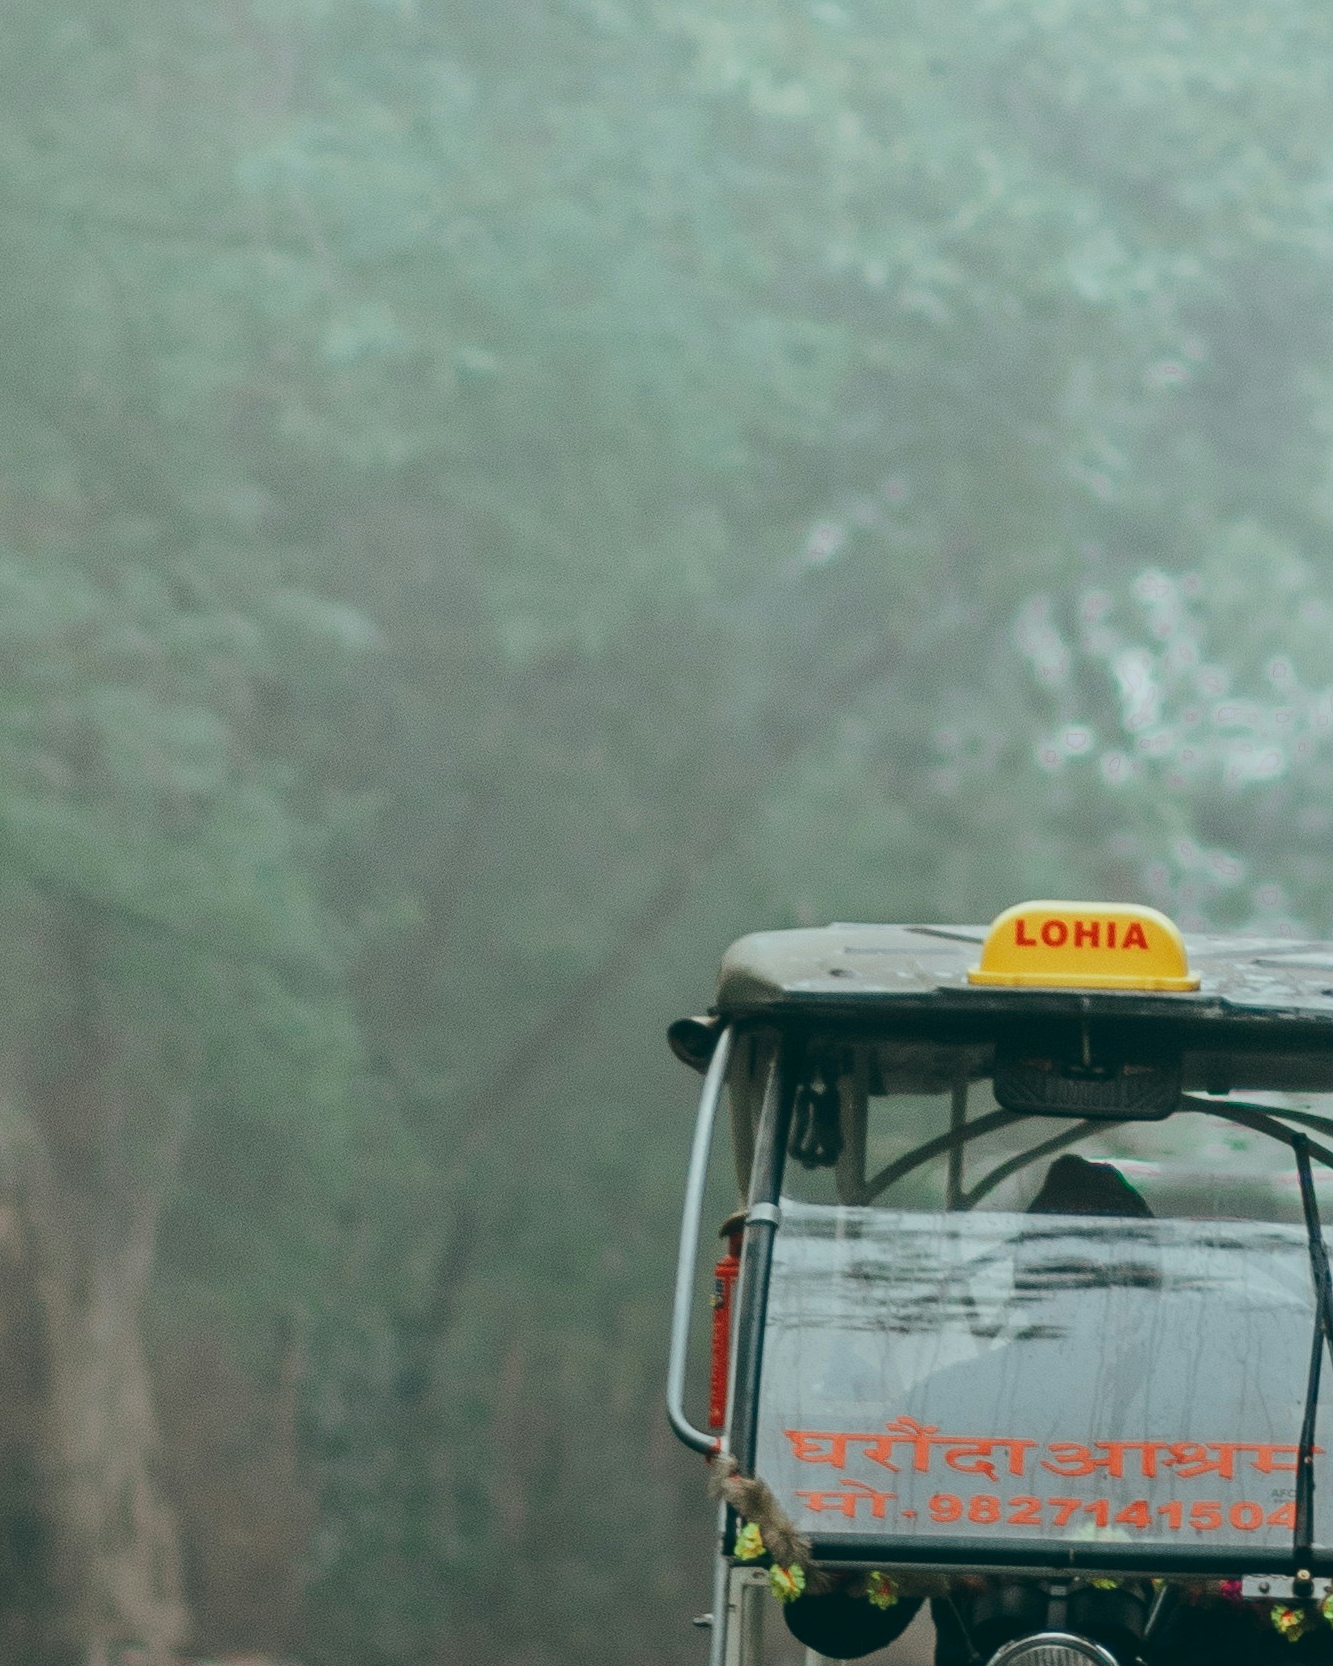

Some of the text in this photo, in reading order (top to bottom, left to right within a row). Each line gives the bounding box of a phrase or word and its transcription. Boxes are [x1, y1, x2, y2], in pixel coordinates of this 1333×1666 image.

[1015, 919, 1149, 950] LOHIA
[784, 1415, 1324, 1482] घरौंदा आश्रम
[928, 1493, 1297, 1531] 9827141504
